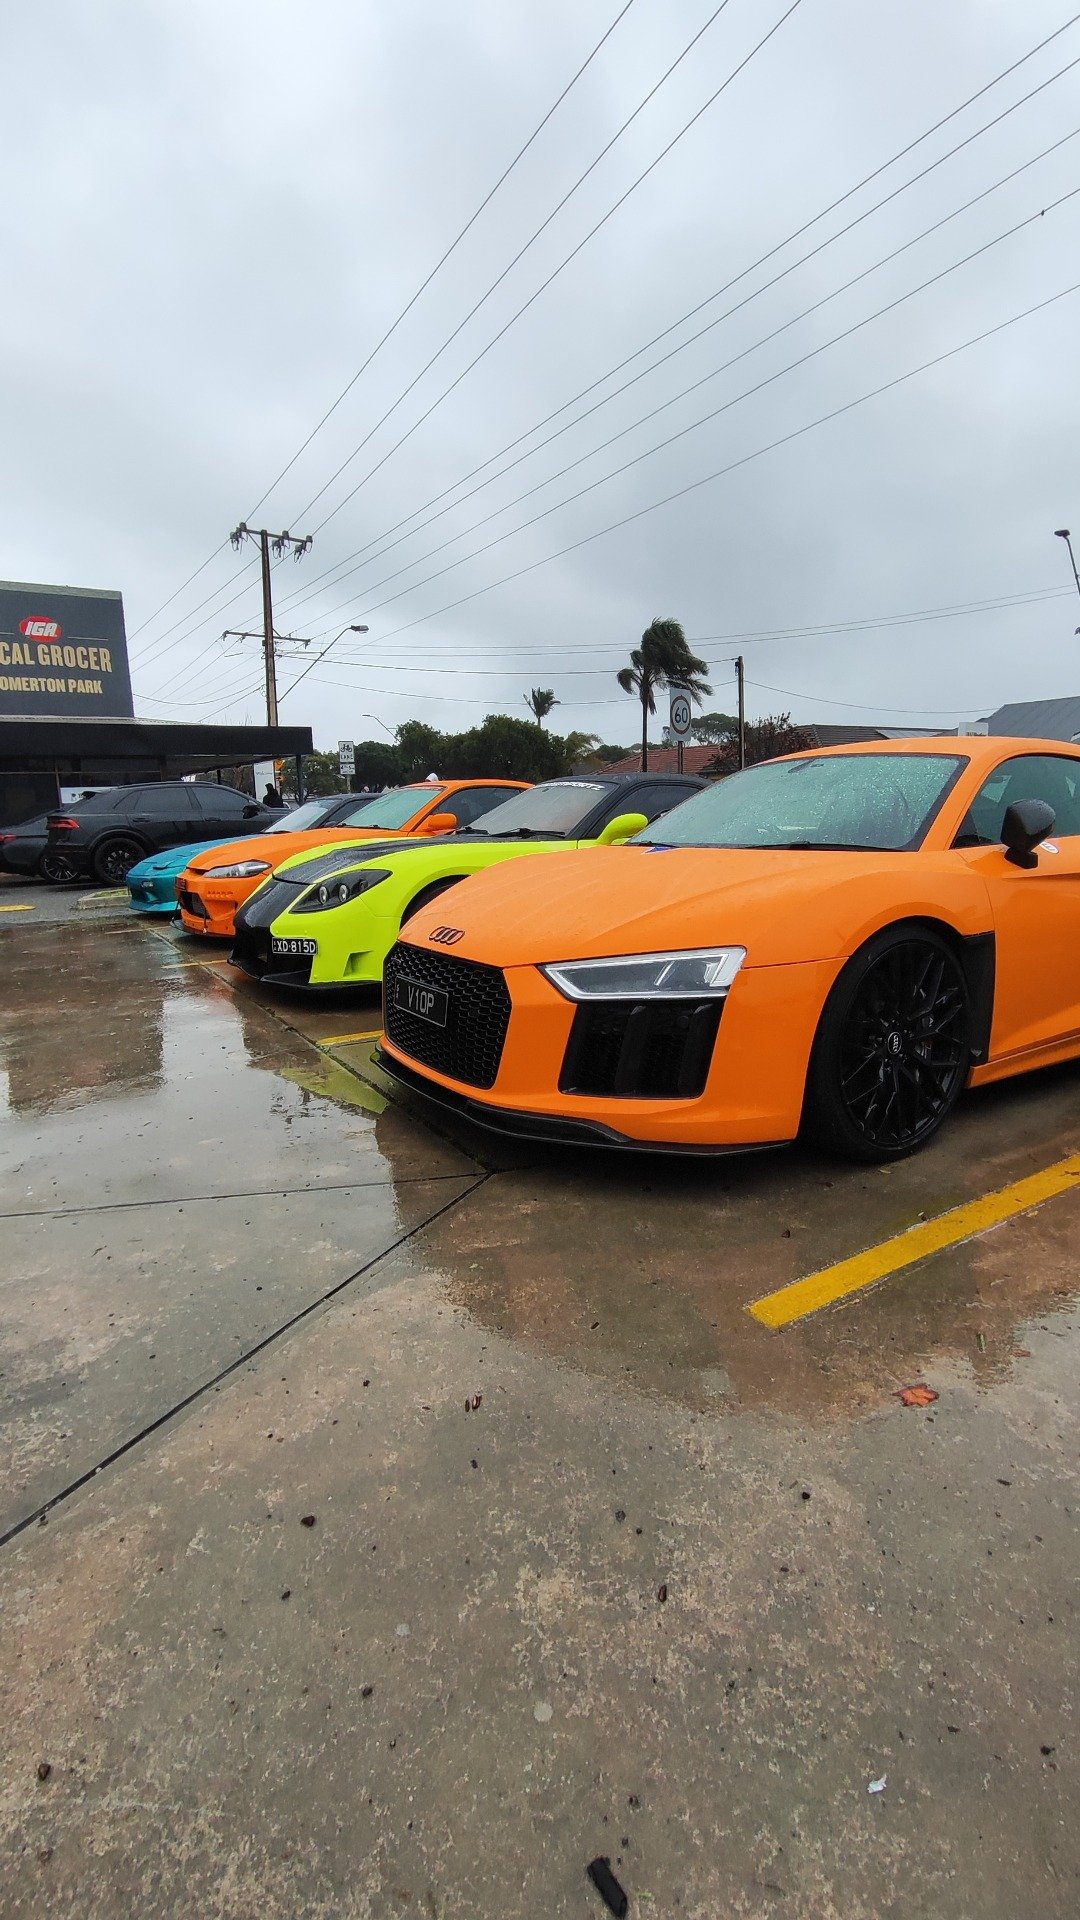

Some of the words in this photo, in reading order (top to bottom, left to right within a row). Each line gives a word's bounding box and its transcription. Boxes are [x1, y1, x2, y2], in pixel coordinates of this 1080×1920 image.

[25, 621, 58, 637] IGA
[0, 642, 35, 665] CAL
[37, 644, 112, 673] GROCER
[0, 677, 66, 693] OMERTON
[68, 680, 103, 694] PARK
[675, 706, 688, 723] 60
